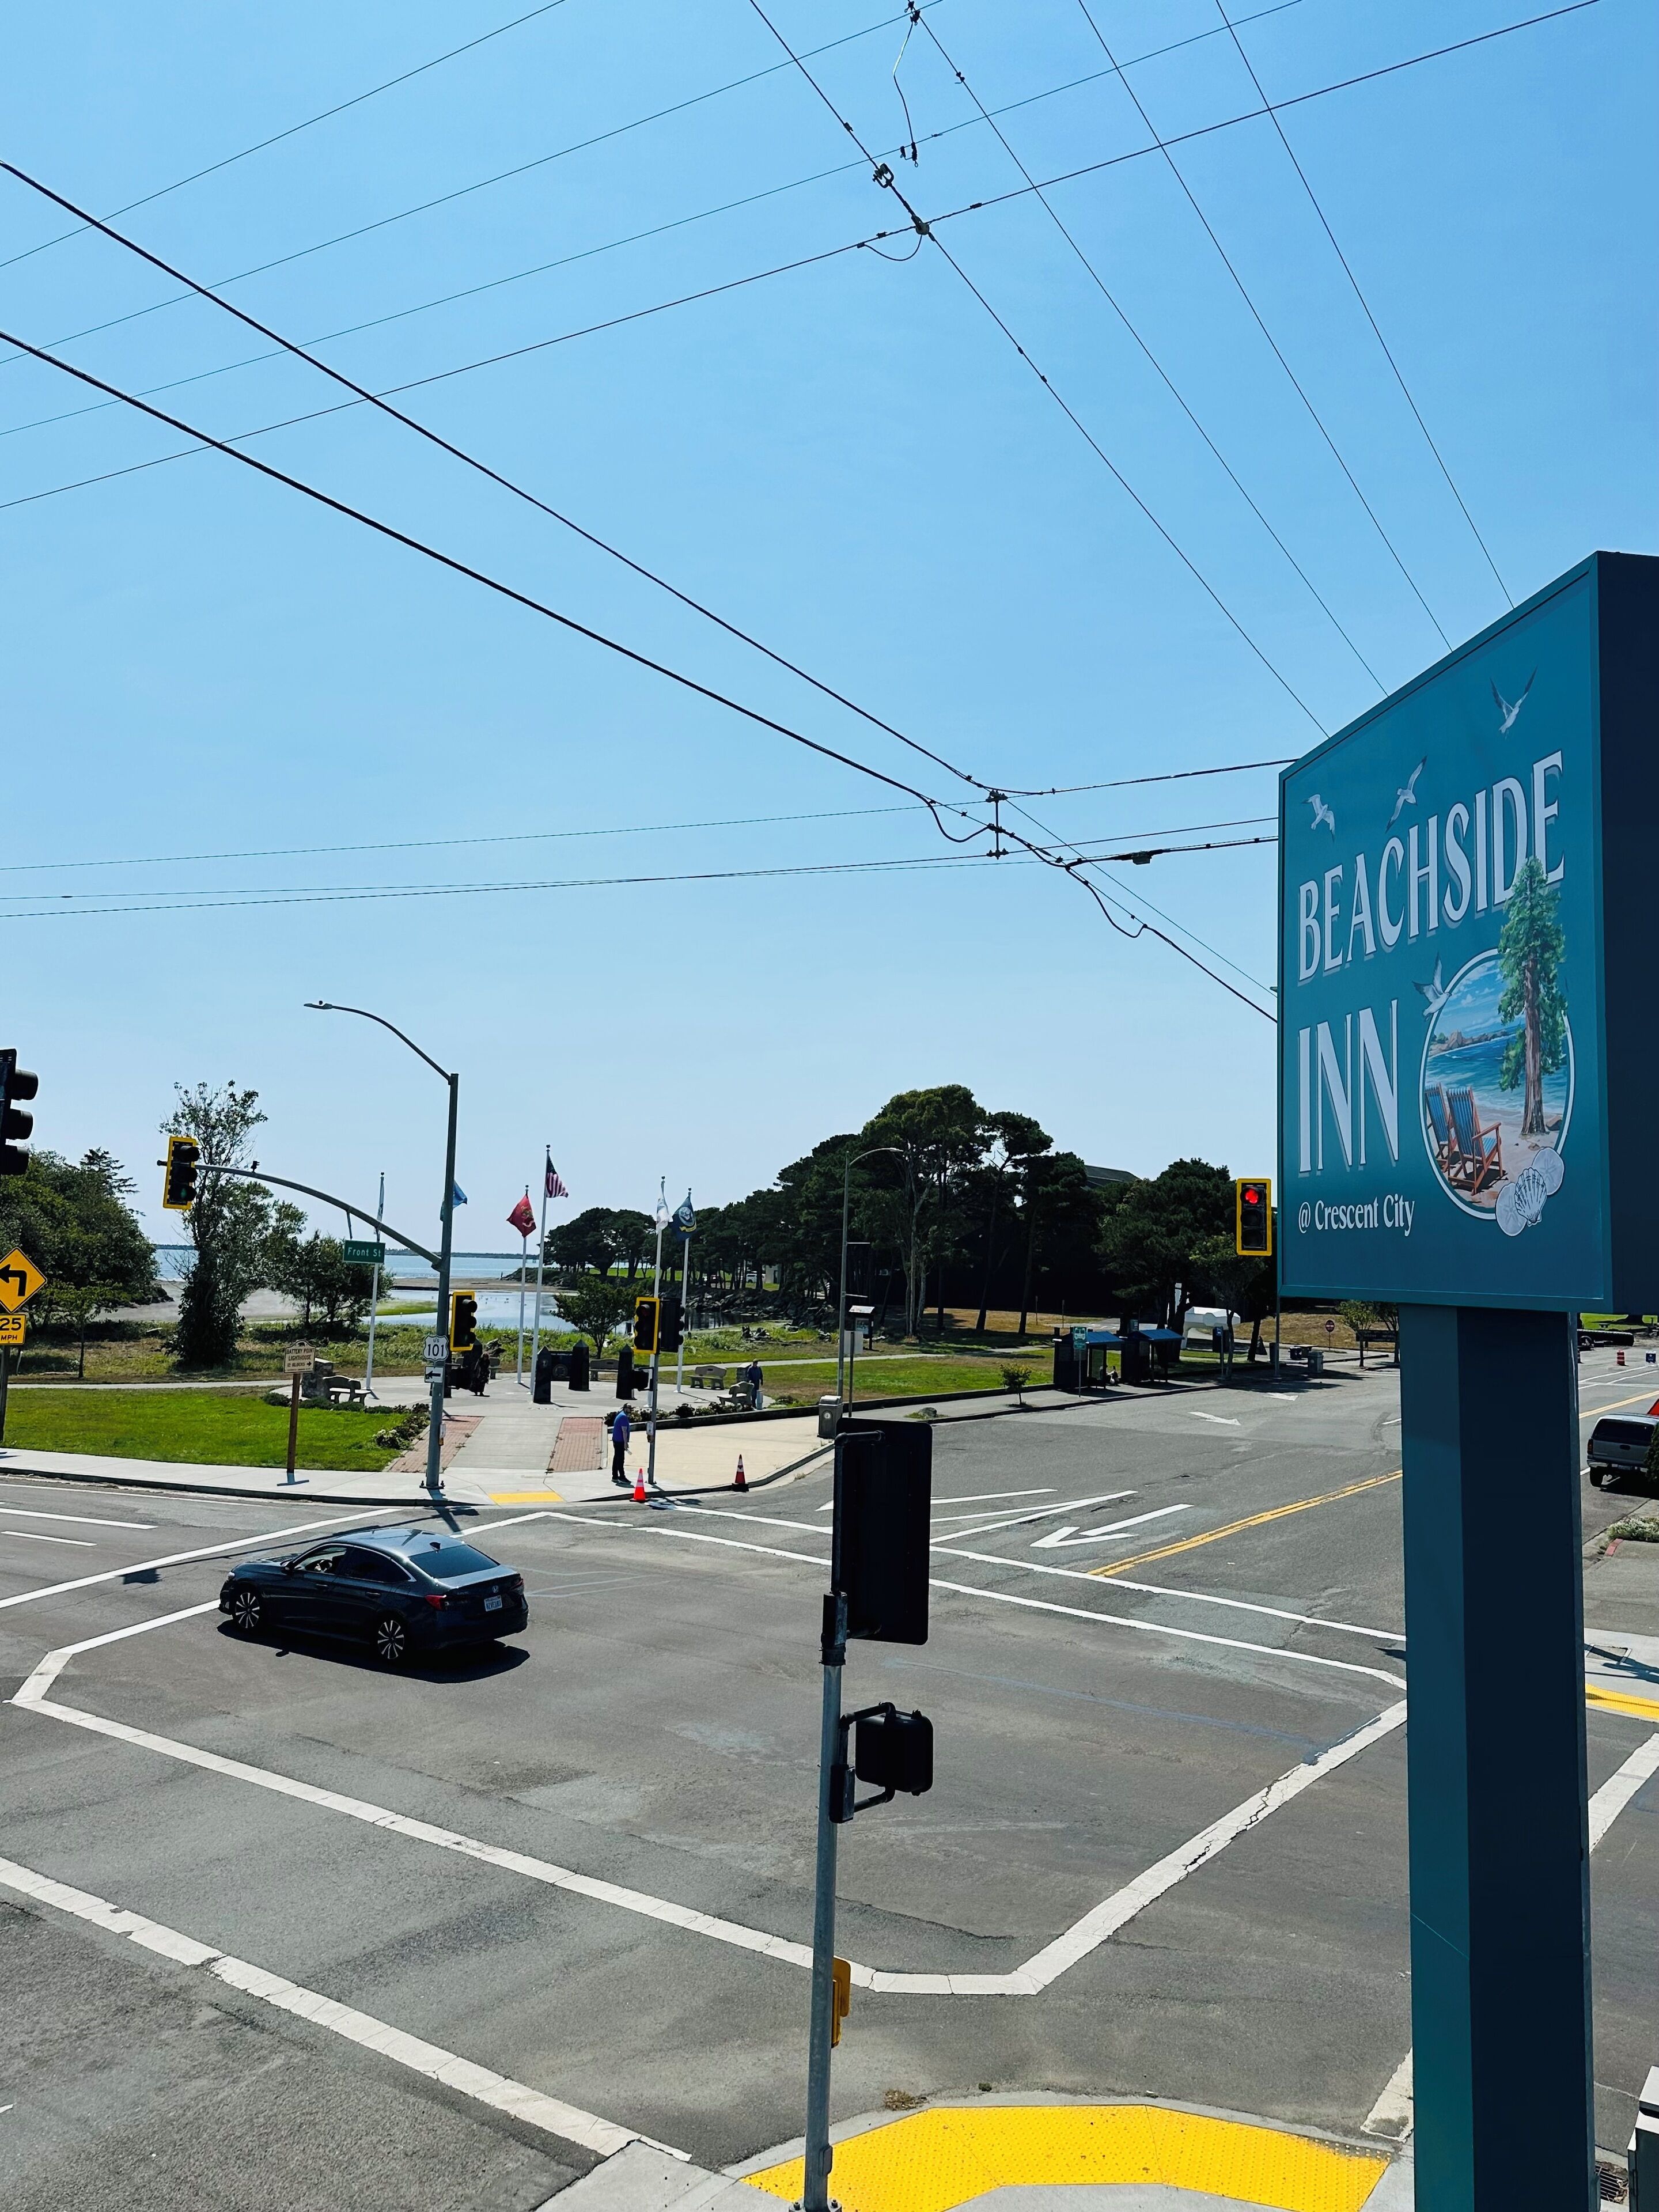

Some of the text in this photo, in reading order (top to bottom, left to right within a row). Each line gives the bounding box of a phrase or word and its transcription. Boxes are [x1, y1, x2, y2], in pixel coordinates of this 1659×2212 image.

[1298, 750, 1565, 984] BEACHSIDE
[1298, 999, 1399, 1175] INN
[1299, 1194, 1415, 1237] @ Crescent City
[348, 1247, 381, 1257] Front St
[0, 1318, 21, 1331] 25
[428, 1344, 444, 1357] 101
